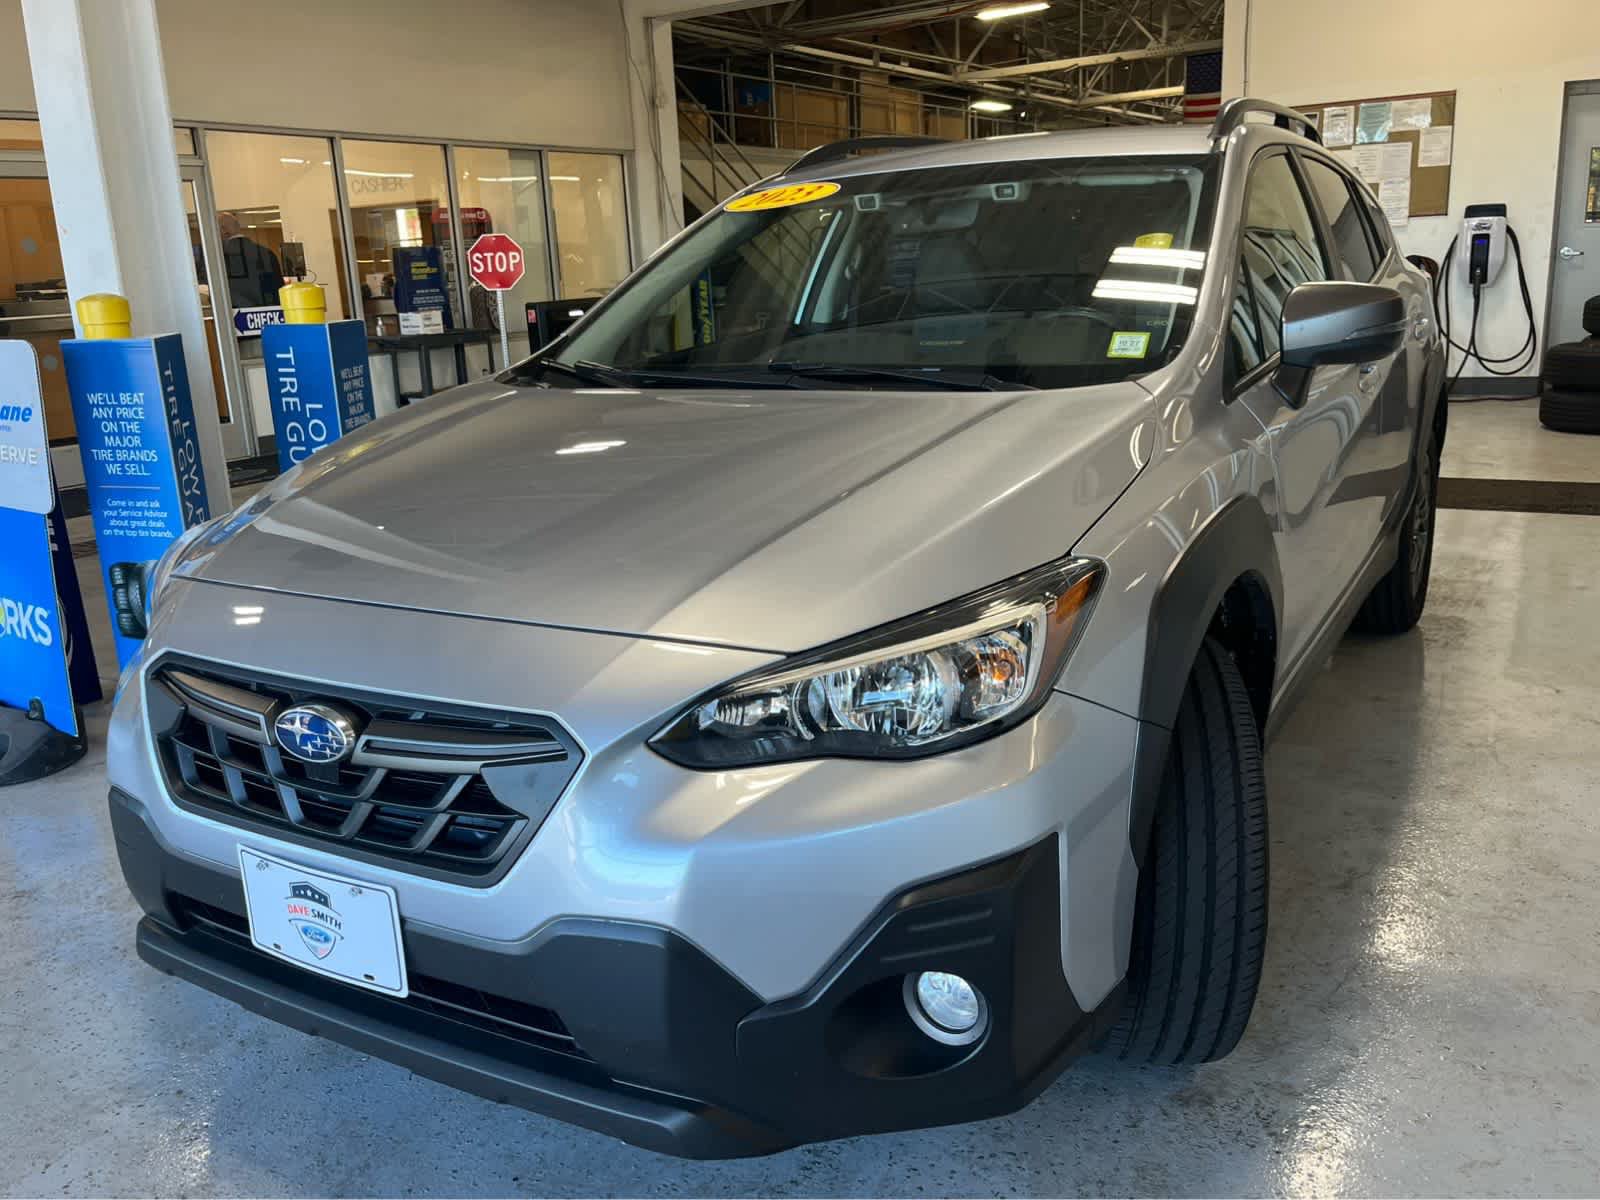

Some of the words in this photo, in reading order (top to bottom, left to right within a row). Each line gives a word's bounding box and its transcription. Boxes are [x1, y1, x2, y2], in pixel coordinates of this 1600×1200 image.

[472, 251, 521, 273] STOP
[246, 312, 284, 329] CHECK-
[276, 346, 301, 412] TIRE
[87, 393, 118, 405] WE'LL
[120, 393, 144, 405] BEAT
[164, 360, 182, 438] TIRE
[0, 405, 32, 422] ane
[92, 407, 113, 419] ANY
[116, 407, 144, 419] PRICE
[101, 421, 118, 433] ON
[120, 421, 141, 433] THE
[105, 435, 142, 448] MAJOR
[286, 421, 306, 465] GU
[0, 444, 38, 464] ERVE
[91, 449, 115, 461] TIRE
[117, 450, 158, 462] BRANDS
[182, 420, 201, 495] LOW
[105, 464, 122, 475] WE
[107, 498, 126, 507] Come
[128, 499, 134, 507] in
[136, 499, 148, 507] and
[150, 499, 160, 508] ask
[103, 510, 117, 519] your
[118, 509, 143, 518] Service
[144, 509, 167, 518] Advisor
[109, 519, 128, 528] about
[130, 520, 147, 529] great
[148, 519, 165, 528] deals
[115, 528, 124, 536] the
[126, 529, 137, 538] top
[138, 529, 149, 537] tire
[0, 597, 52, 647] RKS
[288, 904, 309, 916] DAVE
[311, 908, 342, 930] SMITH
